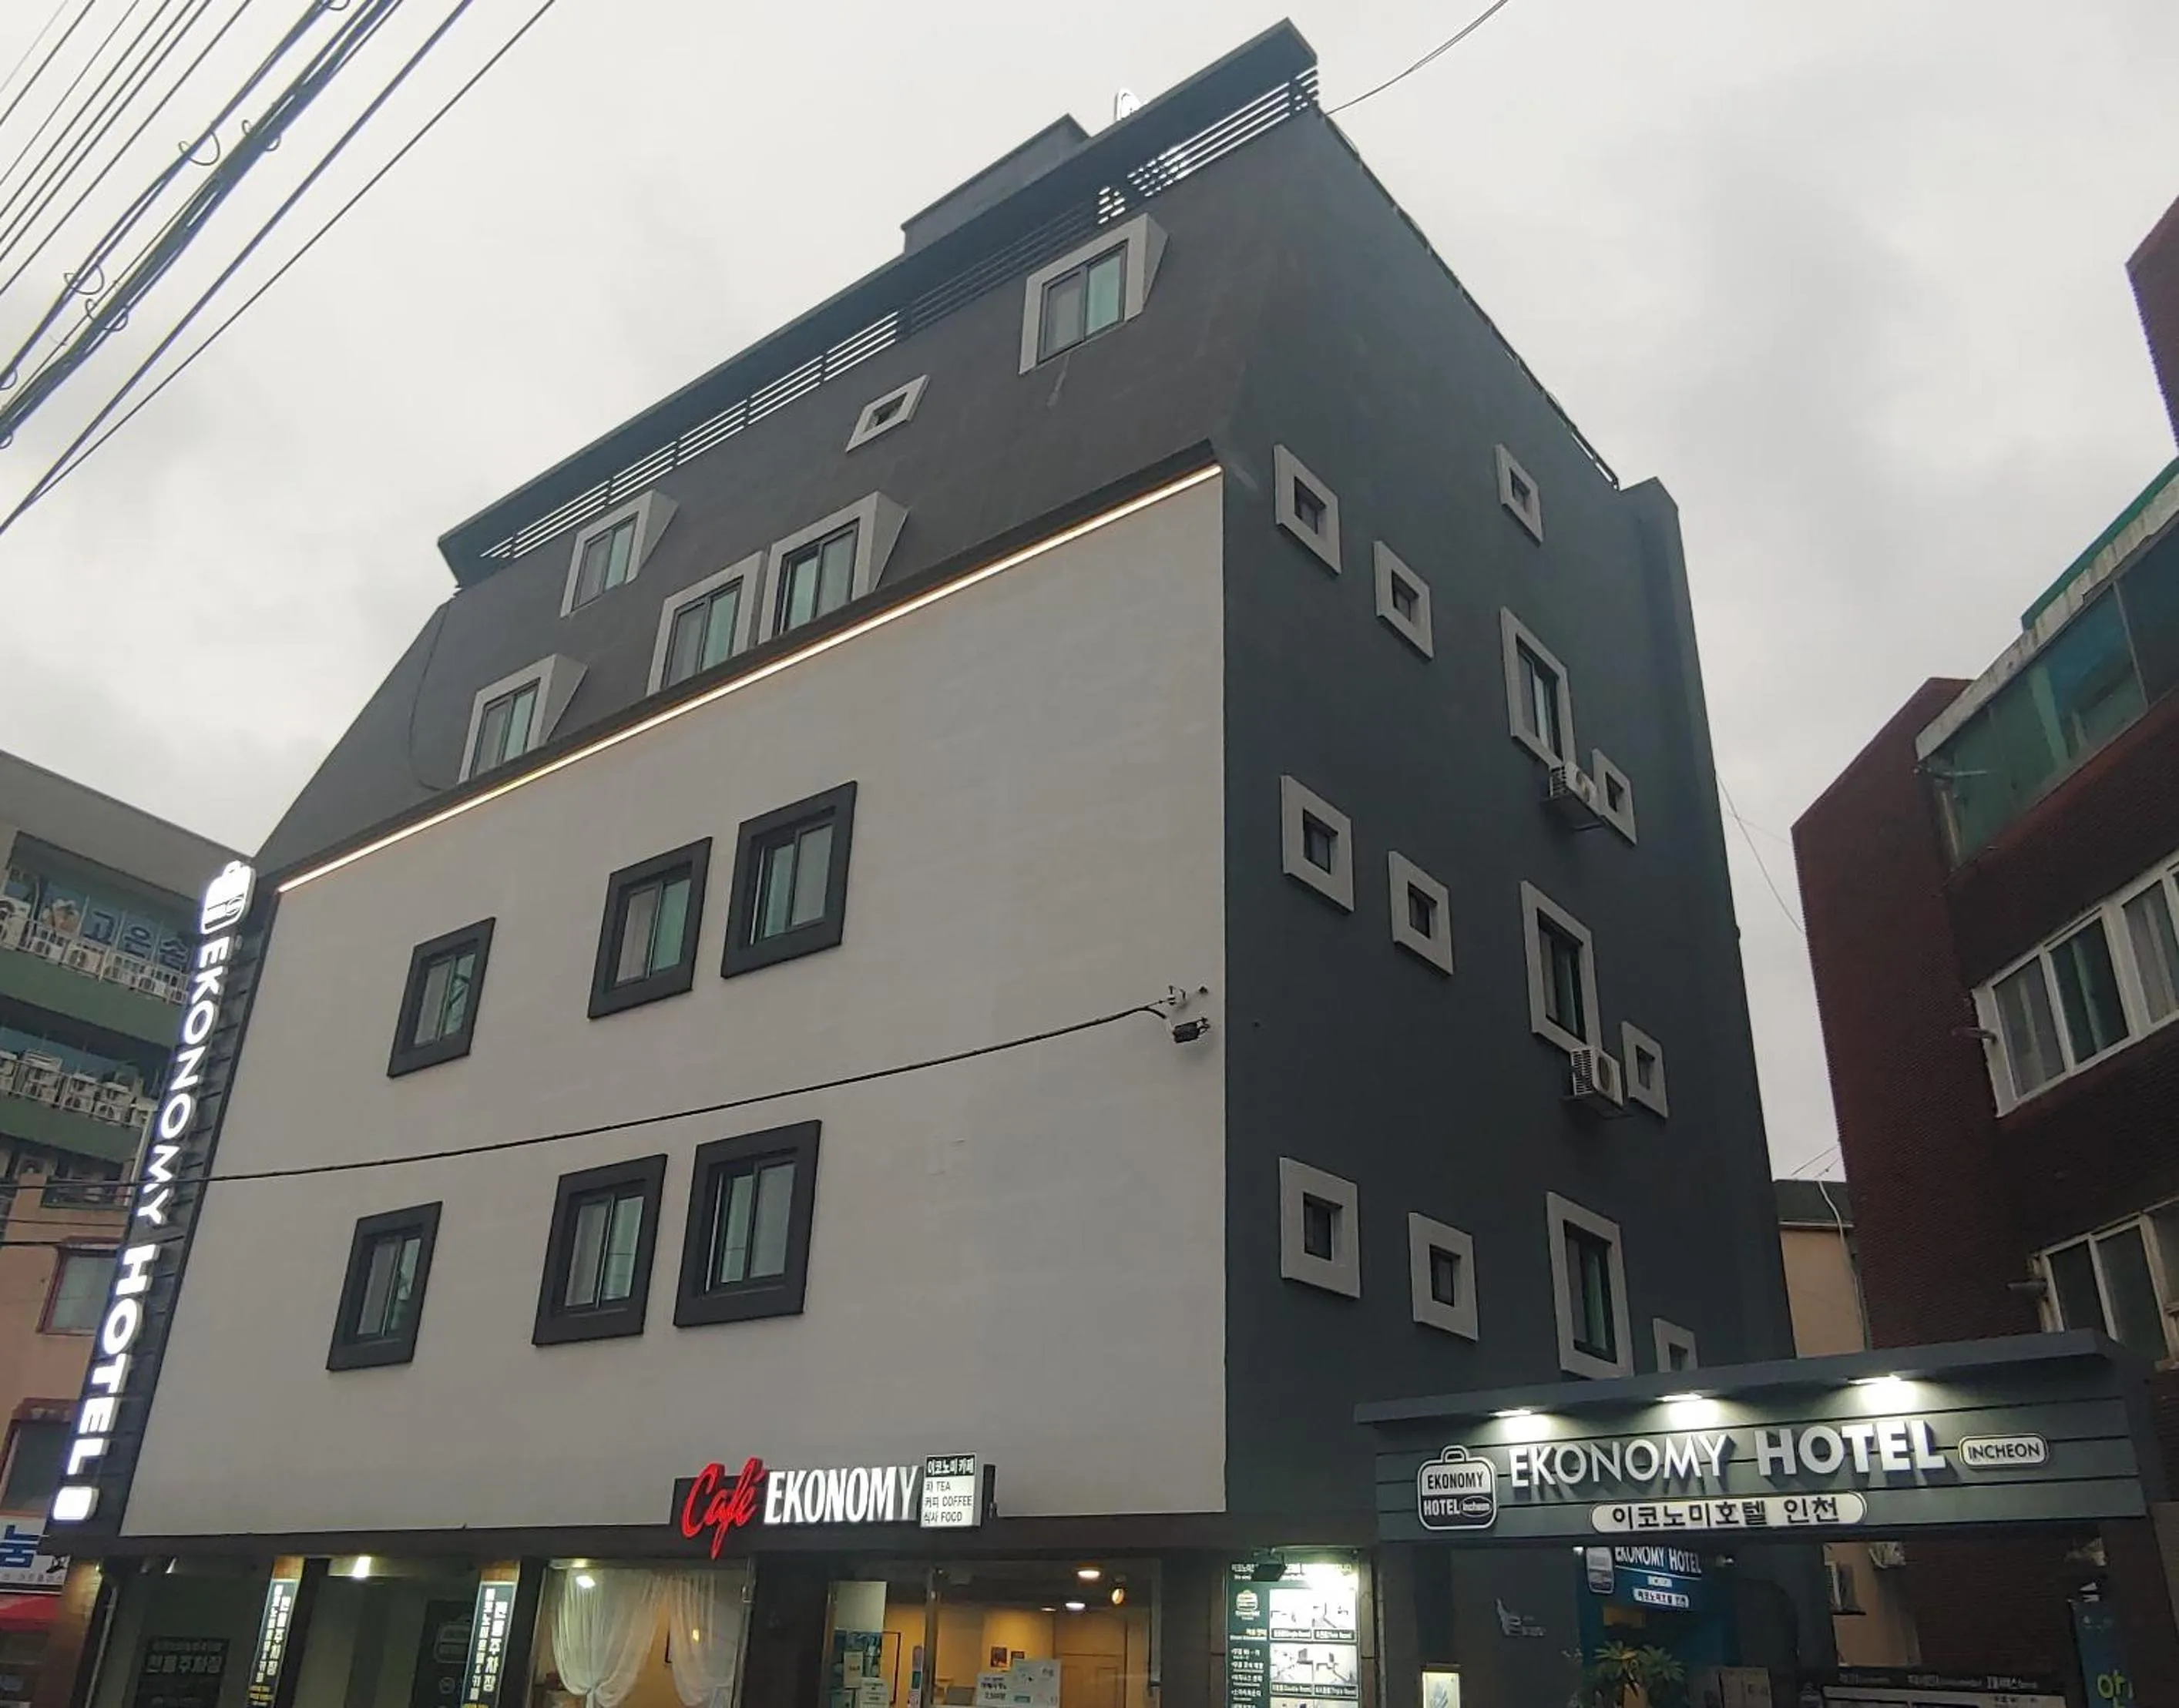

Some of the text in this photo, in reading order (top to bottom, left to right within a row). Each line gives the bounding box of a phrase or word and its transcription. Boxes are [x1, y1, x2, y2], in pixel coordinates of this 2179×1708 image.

[67, 937, 229, 1475] EKONOMY HOTEL
[1508, 1420, 2040, 1488] EKONOMY HOTEL INCHEON
[936, 1481, 951, 1492] TEA
[1427, 1471, 1484, 1490] EKONOMY
[682, 1456, 919, 1560] Café EKONOMY
[942, 1495, 972, 1507] COFFEE
[1422, 1498, 1460, 1516] HOTEL
[941, 1512, 962, 1522] FOOD
[1612, 1497, 1840, 1530] 이코노미호텔 인천
[1668, 1549, 1702, 1574] HOTEL
